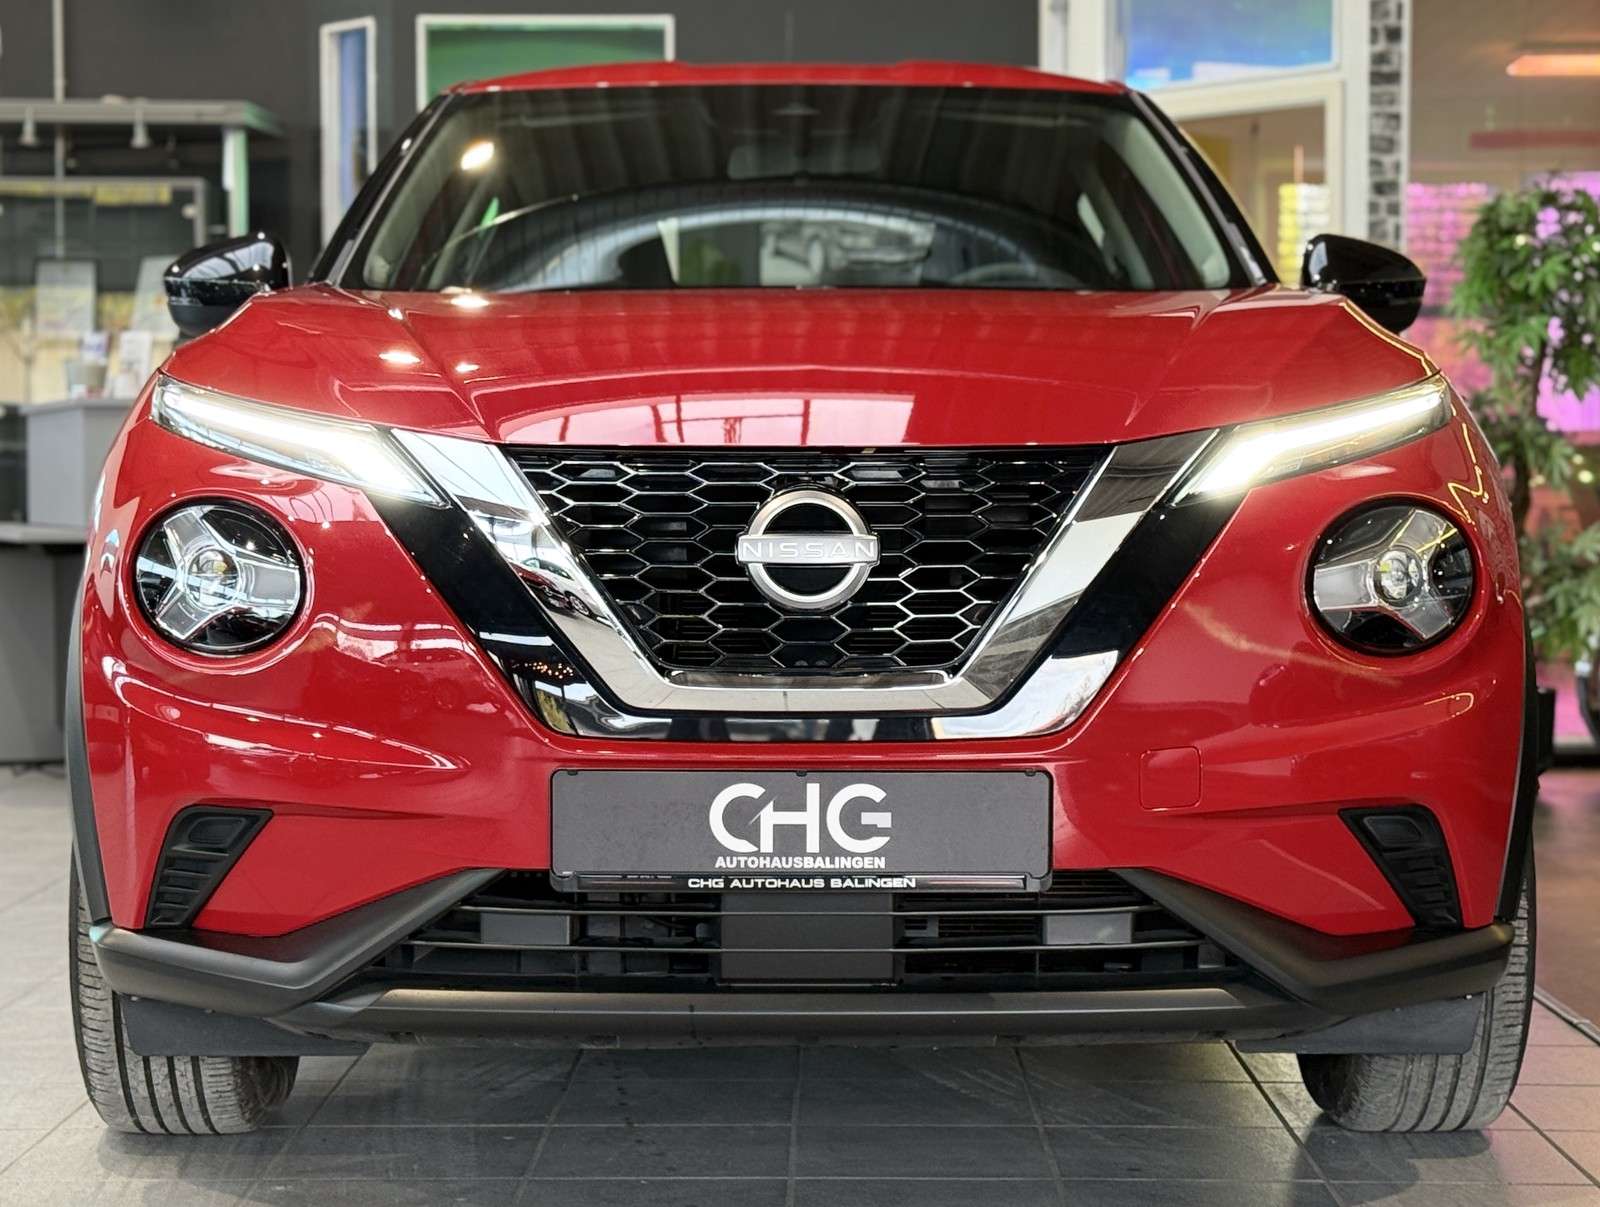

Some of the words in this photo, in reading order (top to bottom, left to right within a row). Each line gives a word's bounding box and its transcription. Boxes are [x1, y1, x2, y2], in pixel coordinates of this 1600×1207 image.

[742, 541, 875, 559] NISSAN
[708, 783, 892, 853] CHG
[715, 856, 886, 869] AUTOHAUSBALINGEN
[687, 878, 725, 889] CHG
[730, 878, 825, 889] AUTOHAUS
[830, 878, 917, 889] BALINGEN
